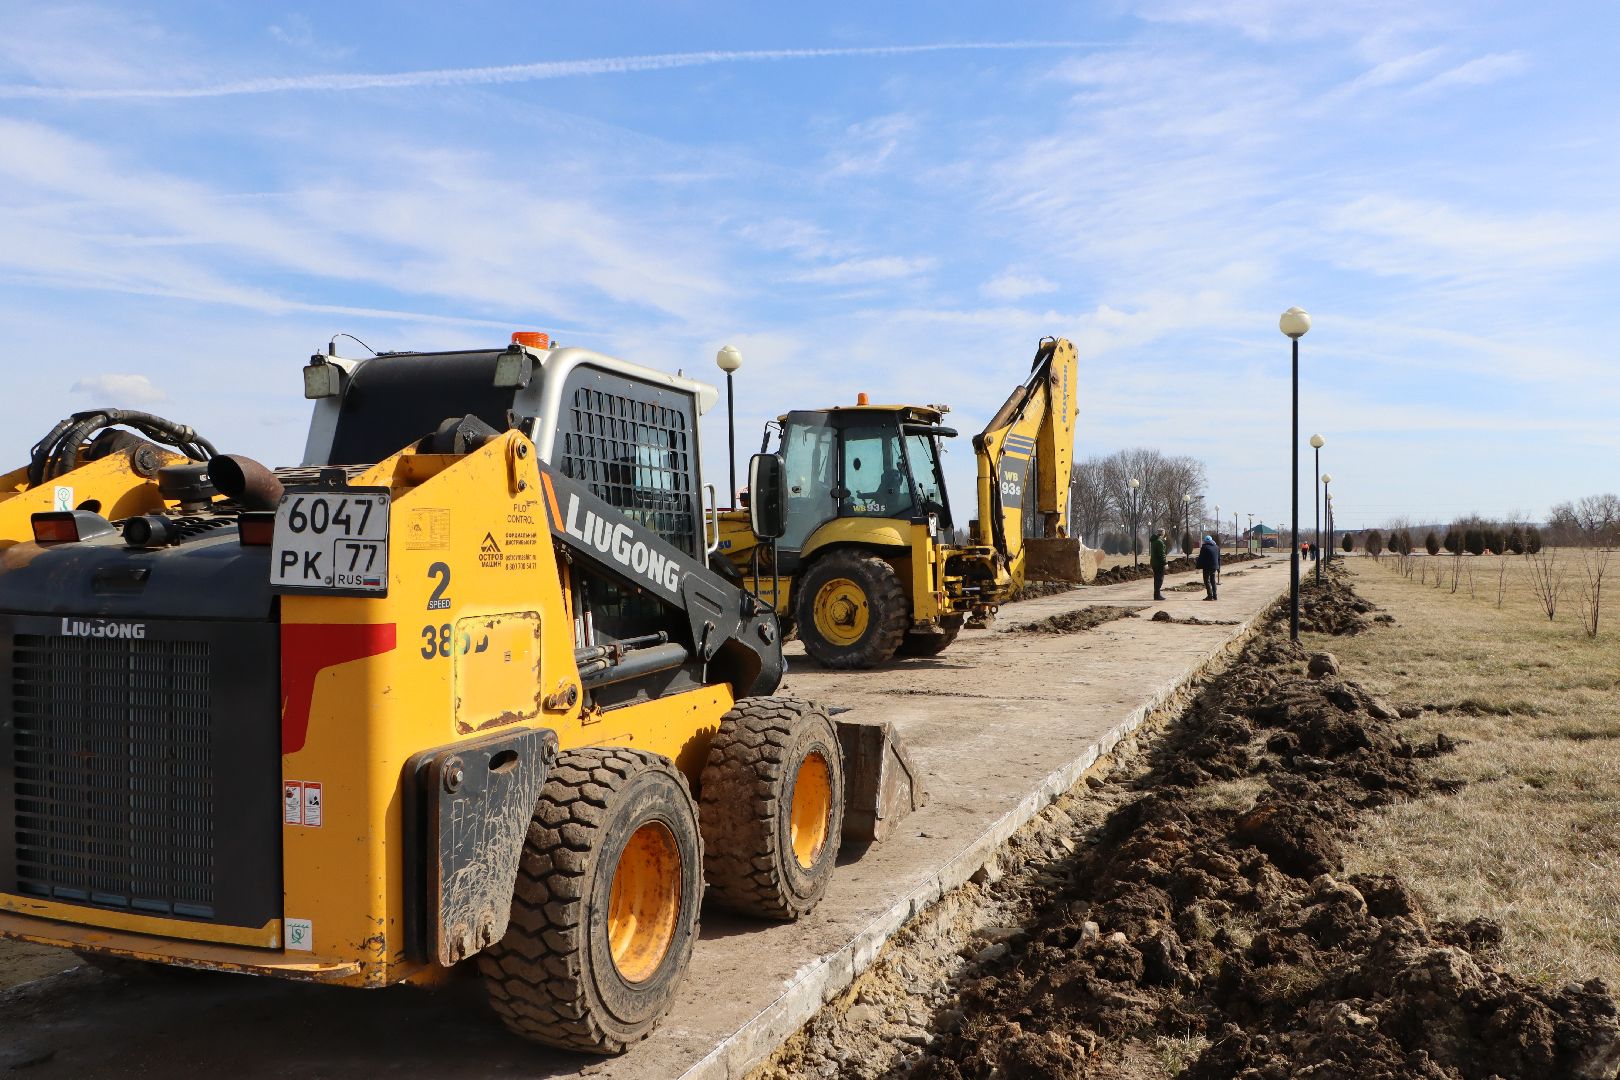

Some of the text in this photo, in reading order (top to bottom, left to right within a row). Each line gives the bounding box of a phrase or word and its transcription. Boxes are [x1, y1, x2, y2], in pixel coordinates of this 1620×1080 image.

[1004, 471, 1019, 481] WB
[288, 497, 373, 536] 6047
[507, 514, 535, 525] CONTROL
[345, 543, 378, 572] 77
[478, 553, 504, 561] ОСТРОВ
[338, 574, 363, 585] RUS
[426, 561, 452, 611] 2
[428, 599, 451, 609] SPEED
